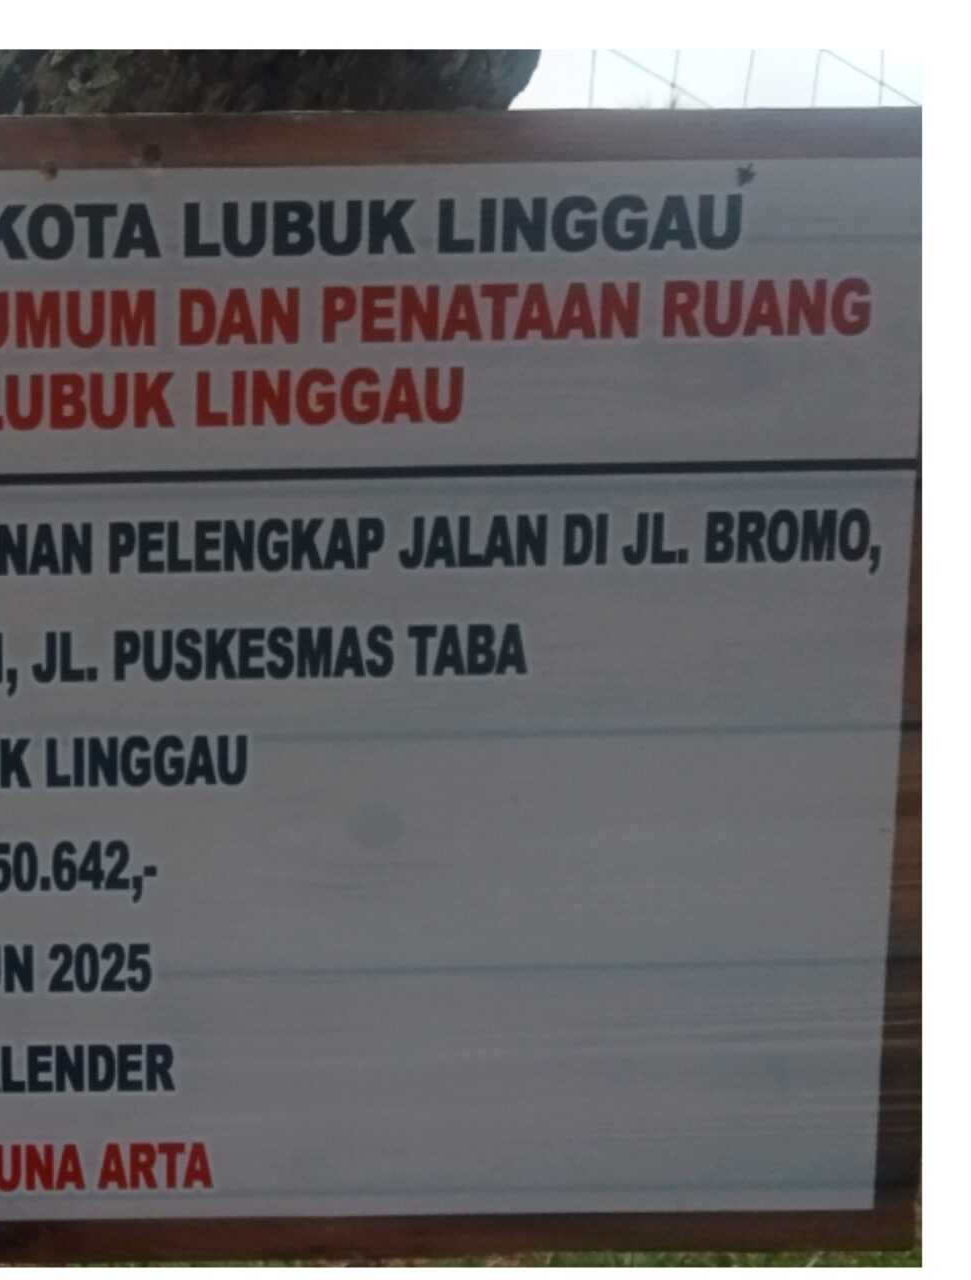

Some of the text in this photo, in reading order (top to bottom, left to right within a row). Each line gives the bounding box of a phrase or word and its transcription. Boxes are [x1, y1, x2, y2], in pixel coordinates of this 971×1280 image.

[183, 199, 415, 258] LUBUK
[437, 194, 743, 255] LINGGAU
[179, 287, 300, 346] DAN
[322, 282, 640, 344] PENATAAN
[662, 277, 871, 338] RUANG
[196, 366, 464, 427] LINGGAU
[108, 517, 385, 574] PELENGKAP
[398, 514, 548, 570] JALAN
[563, 513, 609, 566] DI
[621, 512, 689, 566] JL.
[704, 508, 881, 574] BROMO,
[31, 631, 98, 684] JL.
[113, 625, 394, 682] PUSKESMAS
[407, 623, 528, 677] TABA
[45, 734, 248, 788] LINGGAU
[48, 942, 152, 993] 2025
[97, 1142, 212, 1190] ARTA
